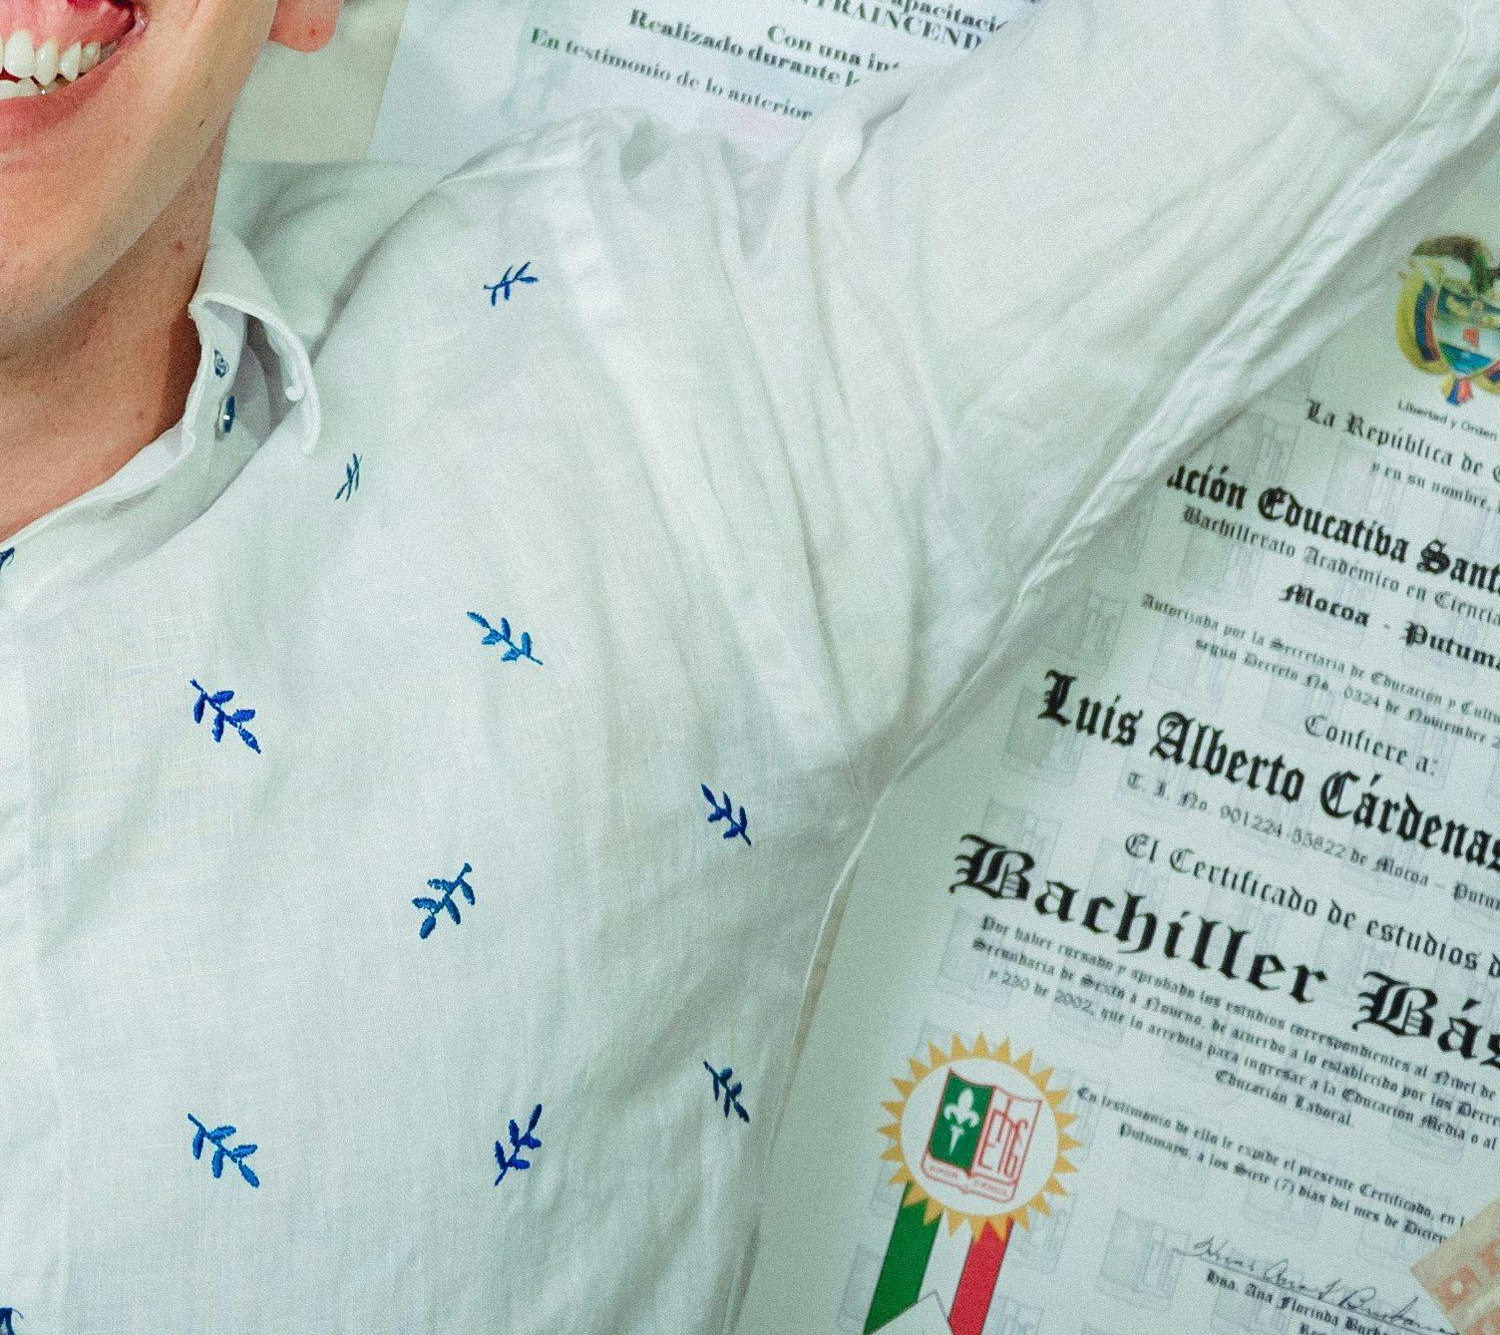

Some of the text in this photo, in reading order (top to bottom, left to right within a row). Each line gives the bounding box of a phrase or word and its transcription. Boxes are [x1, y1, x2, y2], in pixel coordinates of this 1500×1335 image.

[1256, 485, 1409, 563] Educativa
[1038, 668, 1141, 748] Luis
[1151, 710, 1307, 805] Alberto
[948, 832, 1328, 1007] Bachiller
